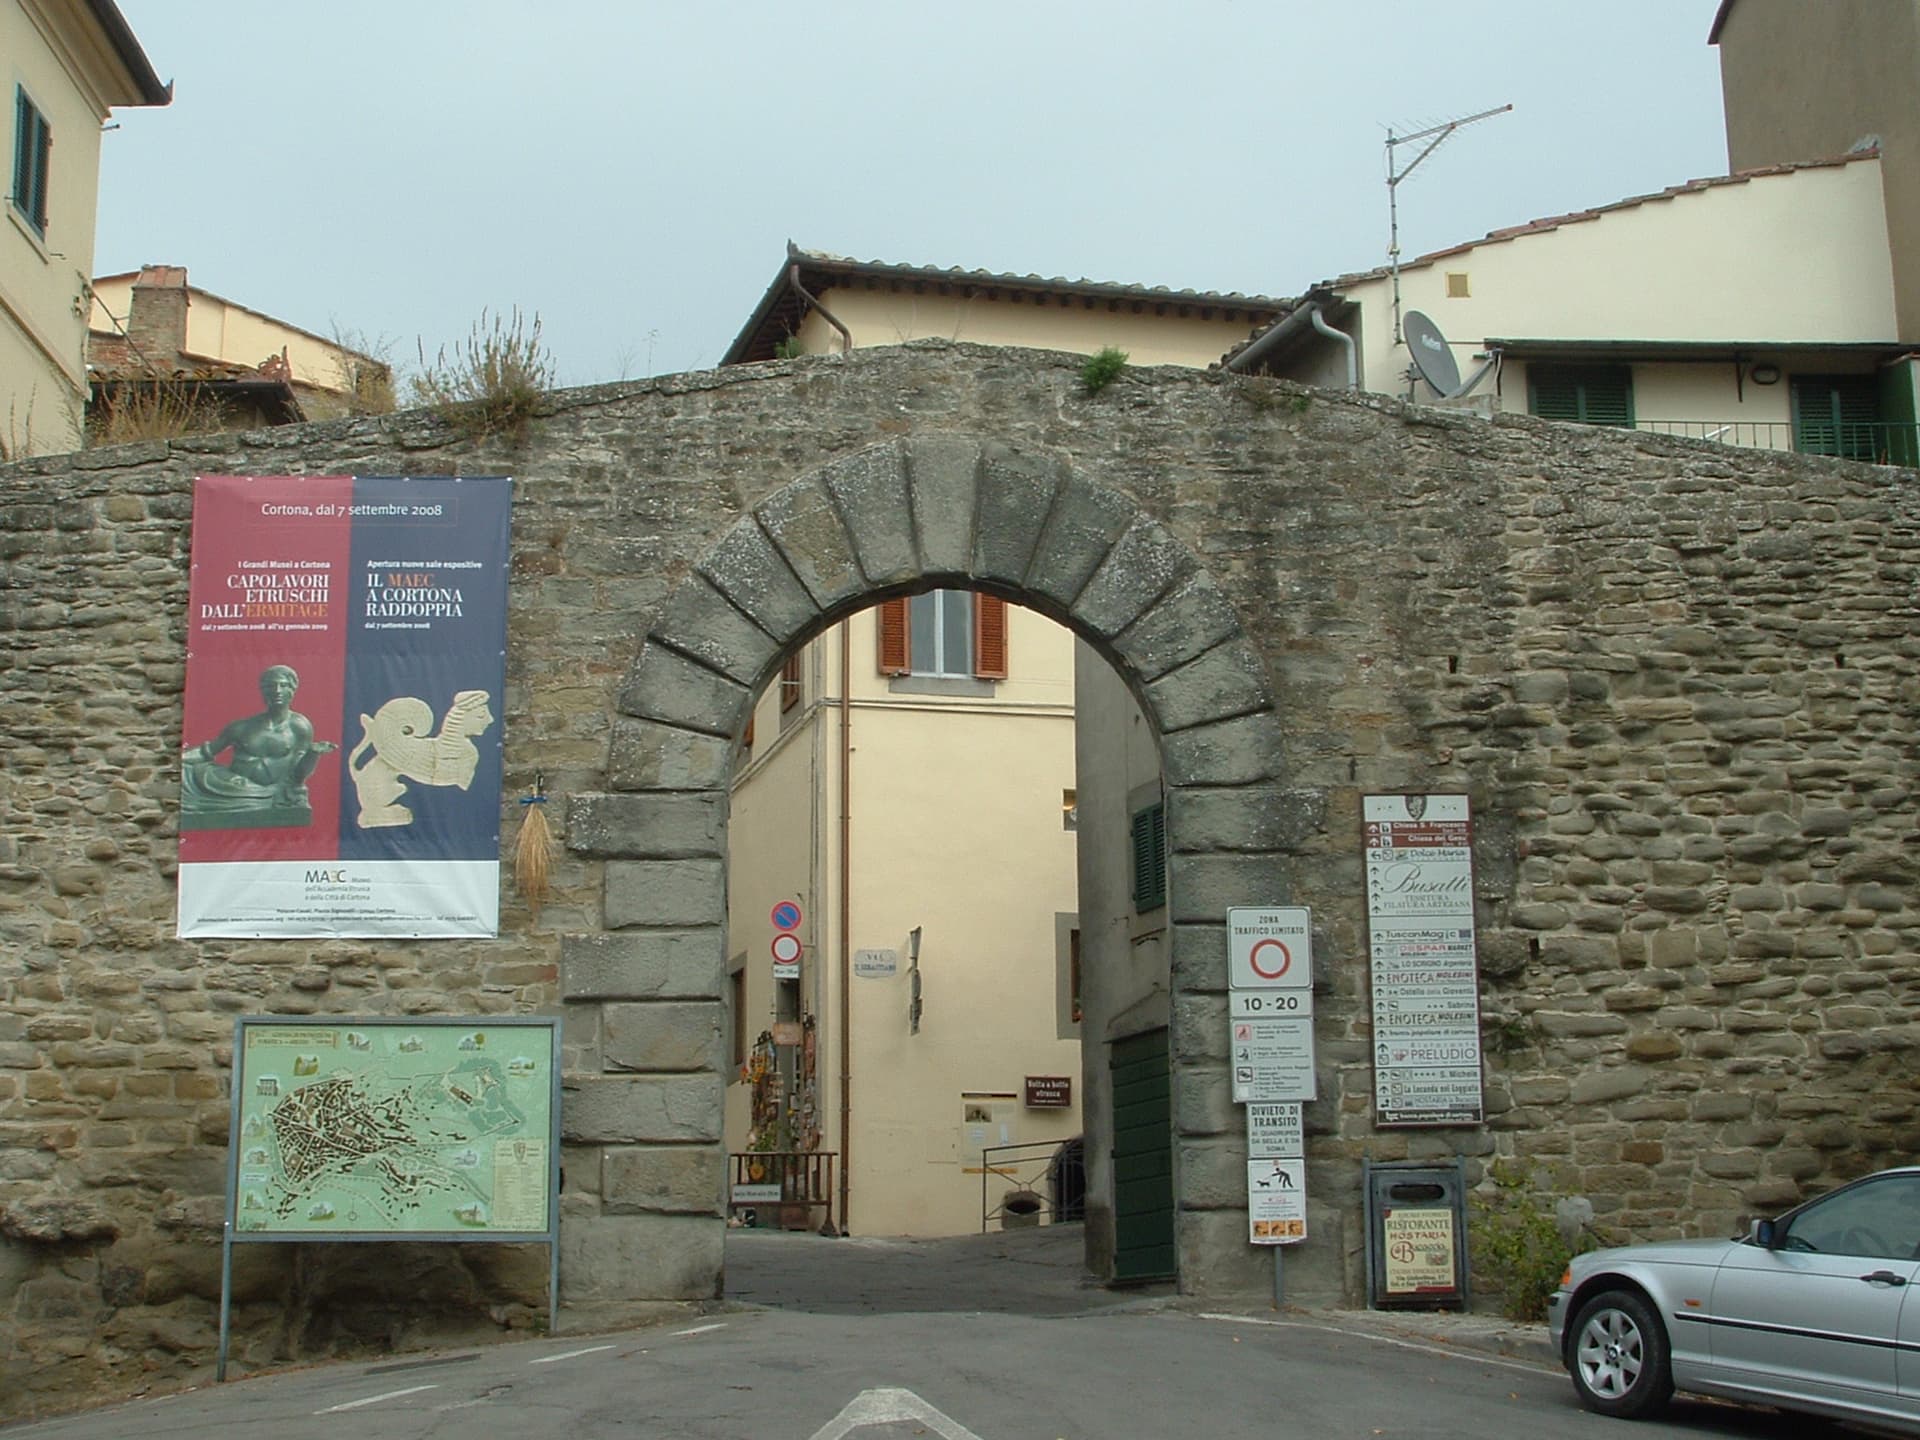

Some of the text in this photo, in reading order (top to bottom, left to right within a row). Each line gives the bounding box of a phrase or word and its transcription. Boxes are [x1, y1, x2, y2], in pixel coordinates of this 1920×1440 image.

[262, 503, 442, 517] Cortona, dal 7 settembre 2008
[367, 560, 400, 569] Apertura
[426, 560, 442, 568] sale
[443, 561, 482, 569] espositive
[227, 574, 329, 589] CAPOLAVORI
[368, 573, 435, 587] IL MAEC
[246, 589, 328, 603] ETRUSCHI
[366, 588, 463, 602] A CORTONA
[201, 603, 328, 618] DALL'ERMITAGE
[366, 602, 463, 617] RADDOPPIA
[1382, 861, 1470, 894] Busatti
[1259, 915, 1279, 924] ZONA
[1234, 926, 1305, 935] TRAFFICO LIMITATO
[1387, 972, 1434, 983] ENOTECA
[1244, 997, 1262, 1010] 10
[1276, 996, 1298, 1010] 20
[1388, 1013, 1437, 1025] ENOTECA
[1410, 1047, 1477, 1061] PRELUDIO
[1251, 1105, 1299, 1116] DIVIETO DI
[1254, 1117, 1298, 1127] TRANSITO
[1387, 1219, 1450, 1230] RISTORANTE
[1390, 1231, 1447, 1240] HOSTARIA
